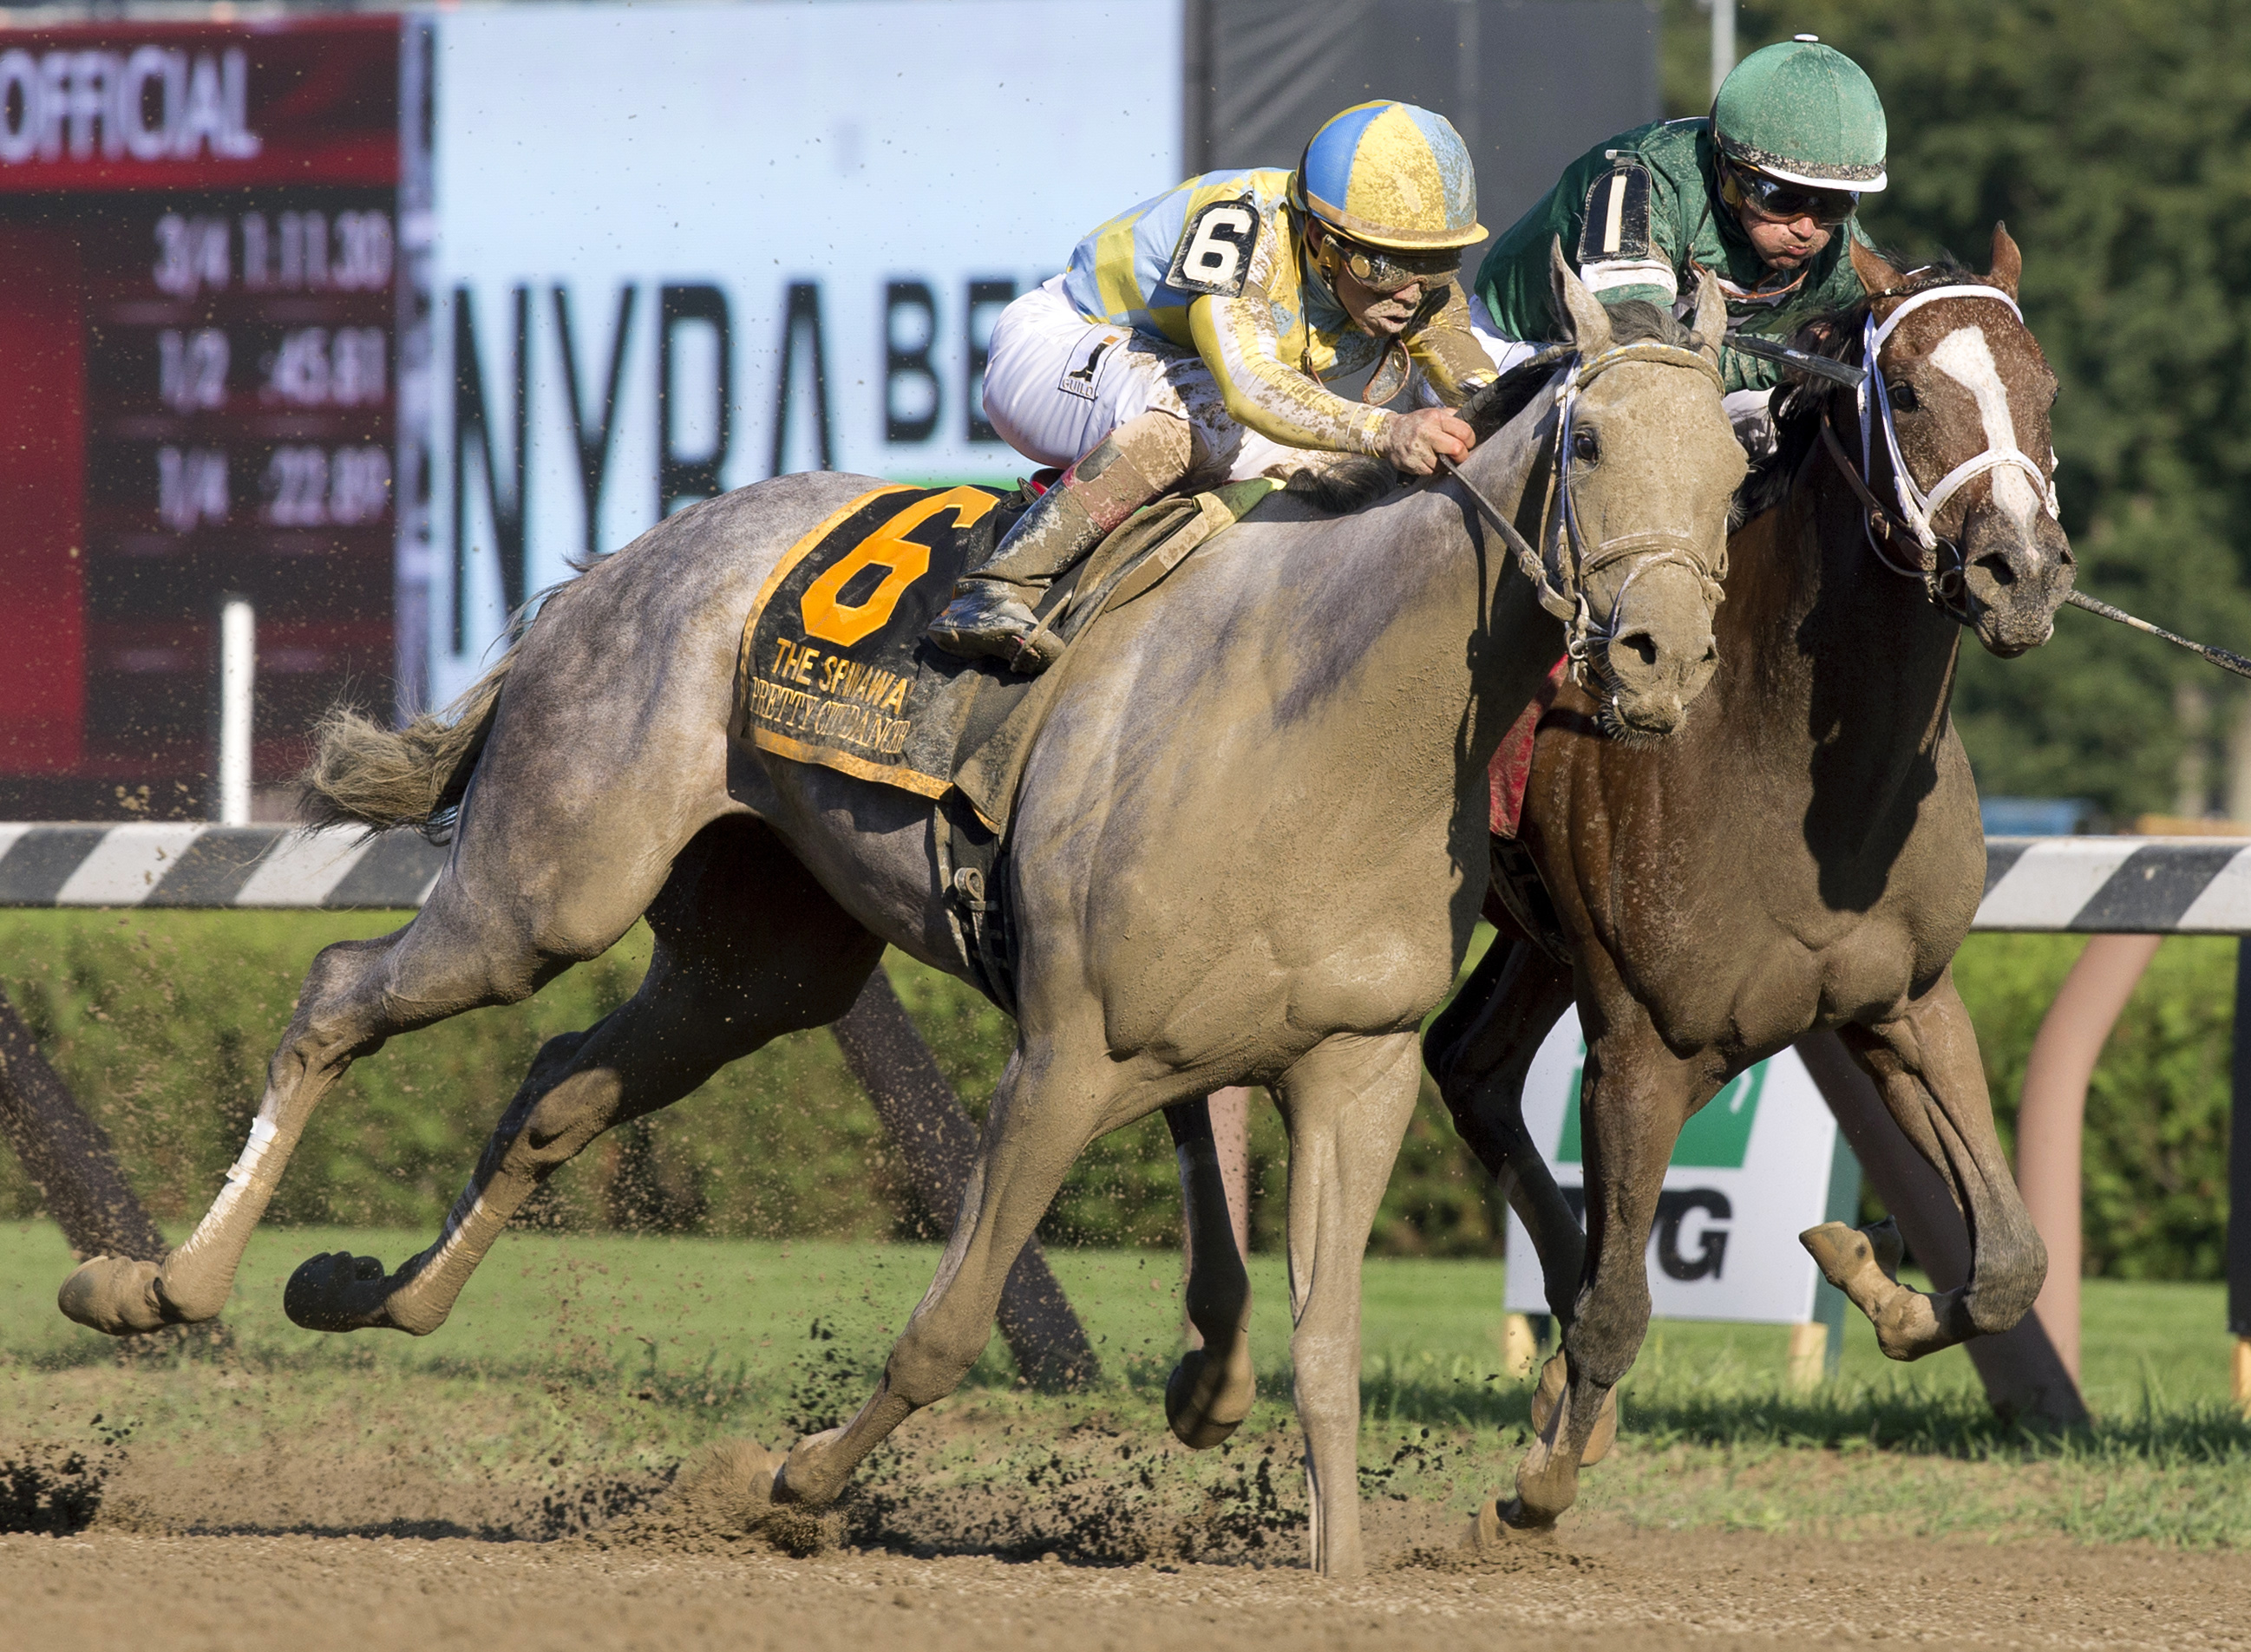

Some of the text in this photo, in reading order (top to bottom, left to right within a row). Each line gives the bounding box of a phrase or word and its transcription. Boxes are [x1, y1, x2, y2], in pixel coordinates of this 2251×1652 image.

[0, 45, 259, 164] OFFICIAL
[1181, 207, 1253, 284] 6
[1602, 174, 1627, 252] 1
[883, 274, 1065, 446] BE
[1062, 378, 1094, 397] GUILD
[801, 485, 1000, 648] 6
[771, 637, 821, 686] THE
[749, 676, 821, 731] PRETTY
